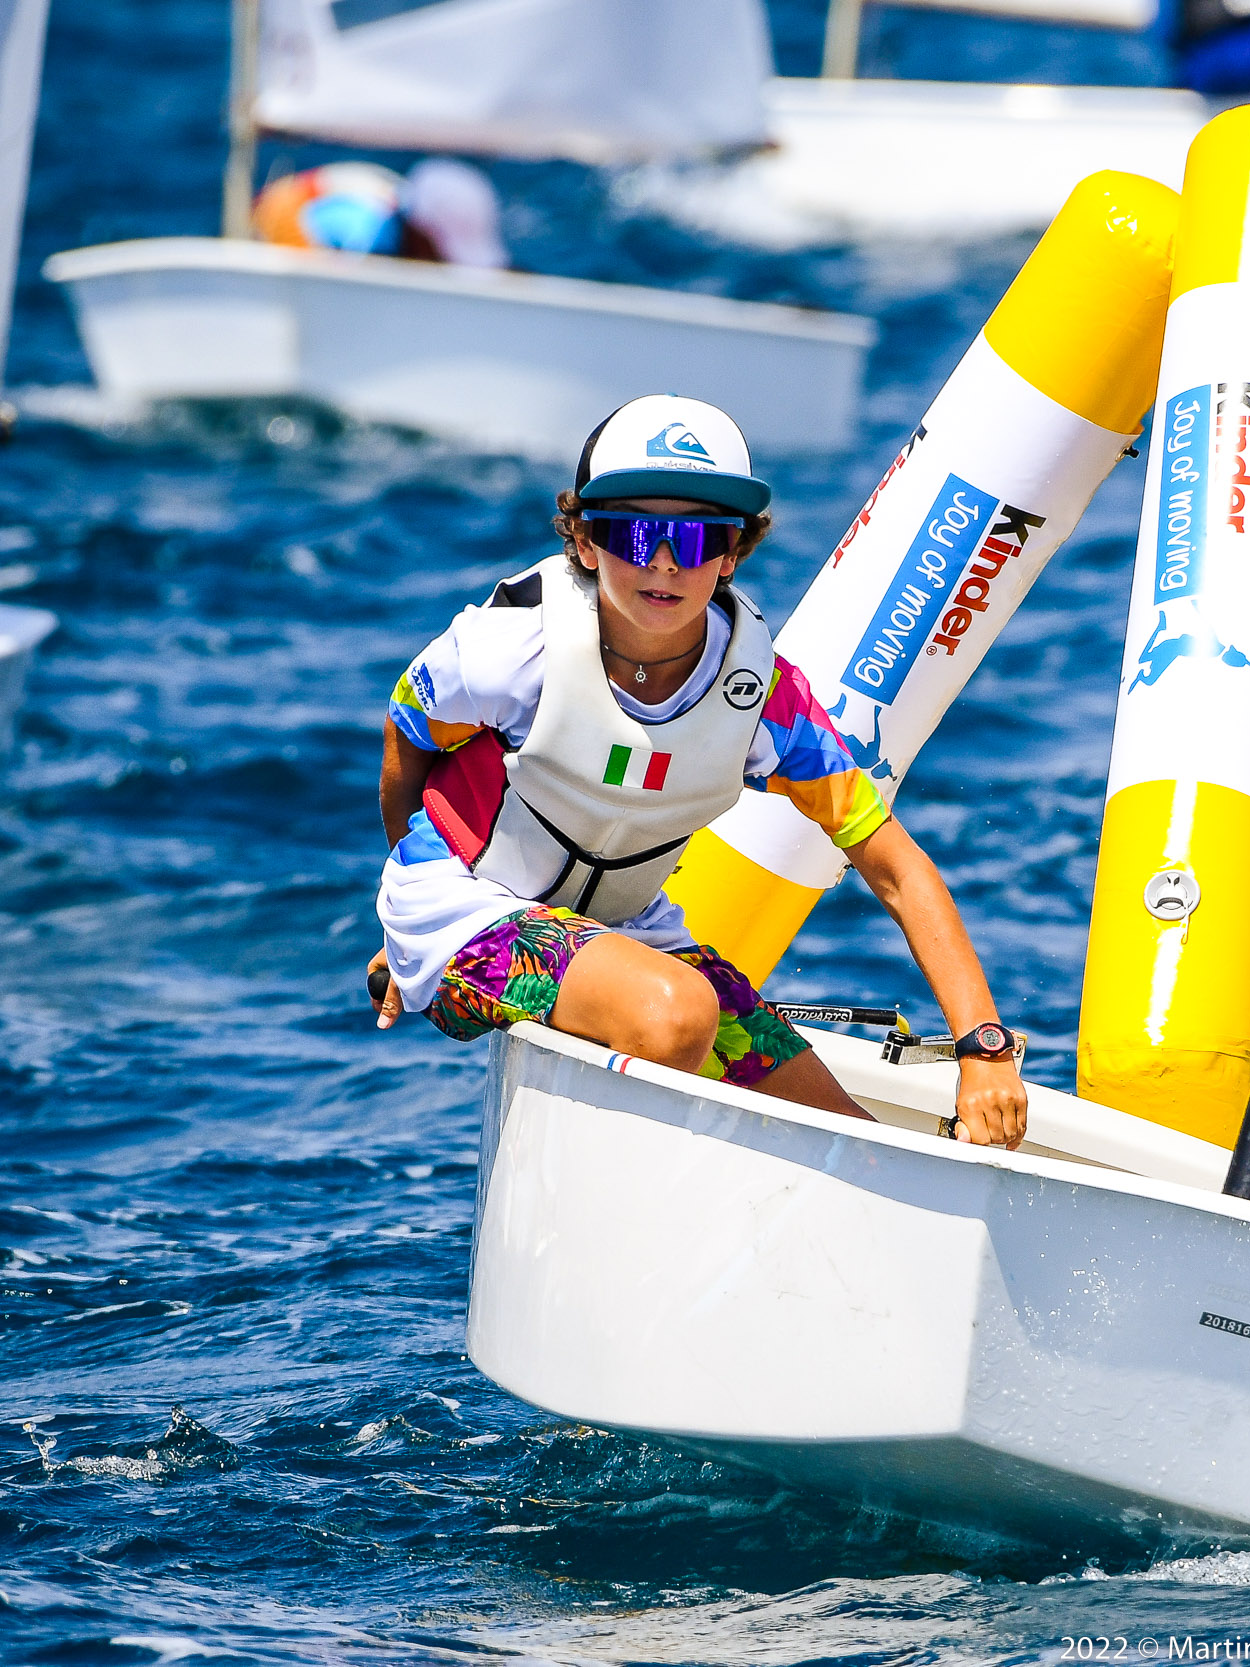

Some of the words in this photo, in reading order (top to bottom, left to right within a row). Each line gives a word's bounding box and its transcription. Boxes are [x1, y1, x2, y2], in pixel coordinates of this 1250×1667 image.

[1167, 400, 1201, 453] Joy
[1169, 456, 1200, 483] of
[928, 491, 979, 548] Joy
[1159, 489, 1197, 592] moving
[915, 549, 948, 589] of
[854, 583, 931, 688] moving
